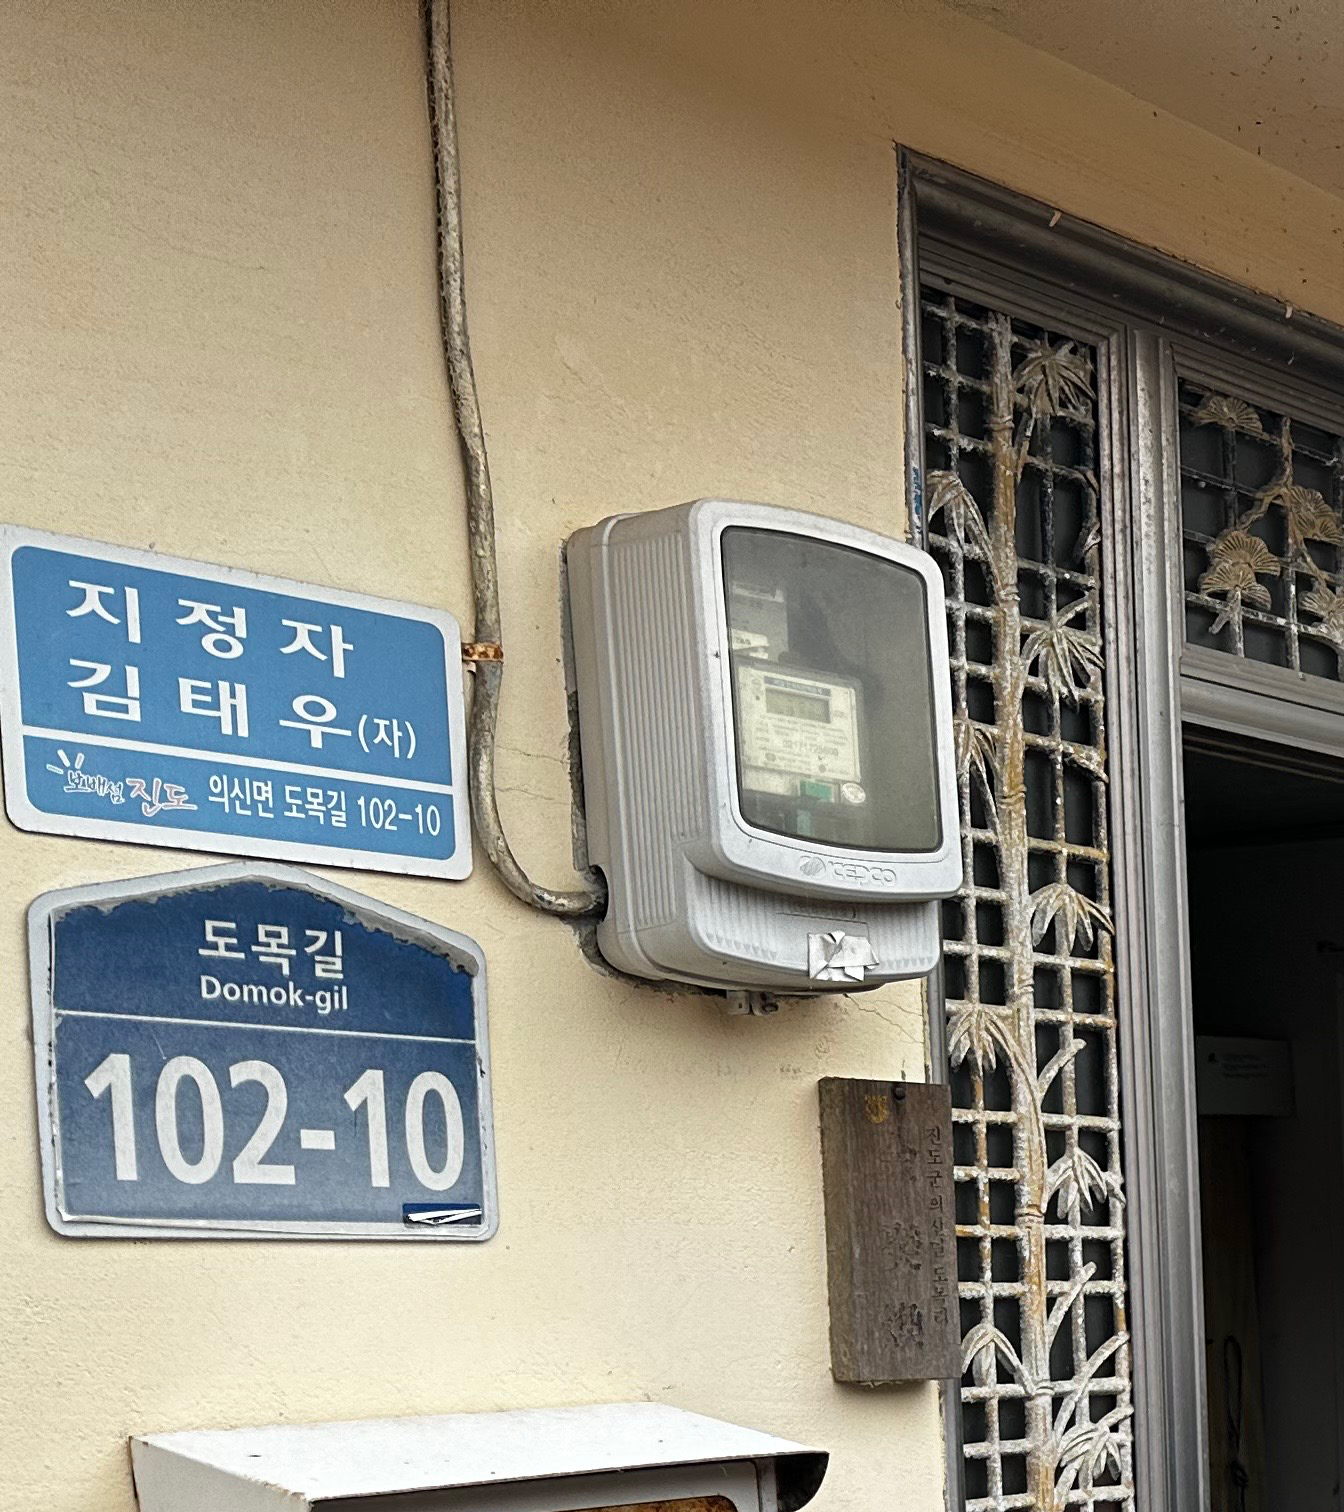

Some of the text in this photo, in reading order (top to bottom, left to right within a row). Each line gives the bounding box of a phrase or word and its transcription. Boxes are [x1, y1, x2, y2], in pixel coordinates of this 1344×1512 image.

[126, 777, 199, 818] 진도
[208, 774, 441, 836] 의신면 도목길 102-10
[198, 919, 344, 979] 도목길
[200, 974, 348, 1015] Domok-gil
[84, 1052, 465, 1192] 102-10
